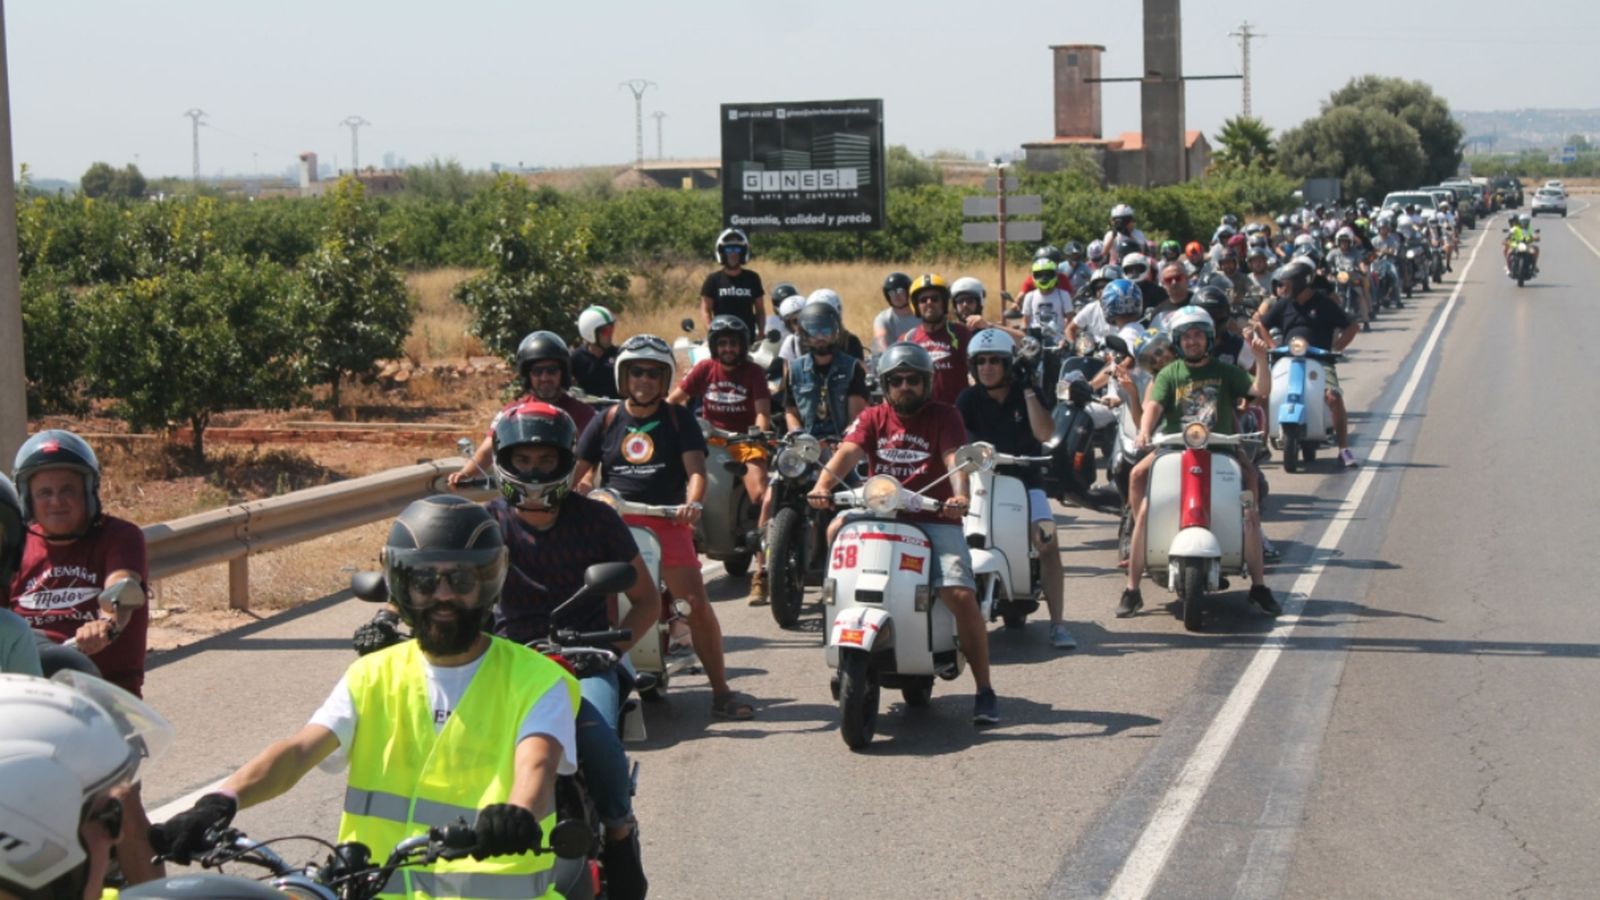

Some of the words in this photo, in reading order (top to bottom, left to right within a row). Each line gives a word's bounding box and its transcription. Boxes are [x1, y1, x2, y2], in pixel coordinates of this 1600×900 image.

[784, 212, 826, 225] calidad
[828, 216, 836, 226] y
[837, 212, 872, 226] precio
[832, 544, 858, 570] 58
[33, 590, 87, 607] Motor
